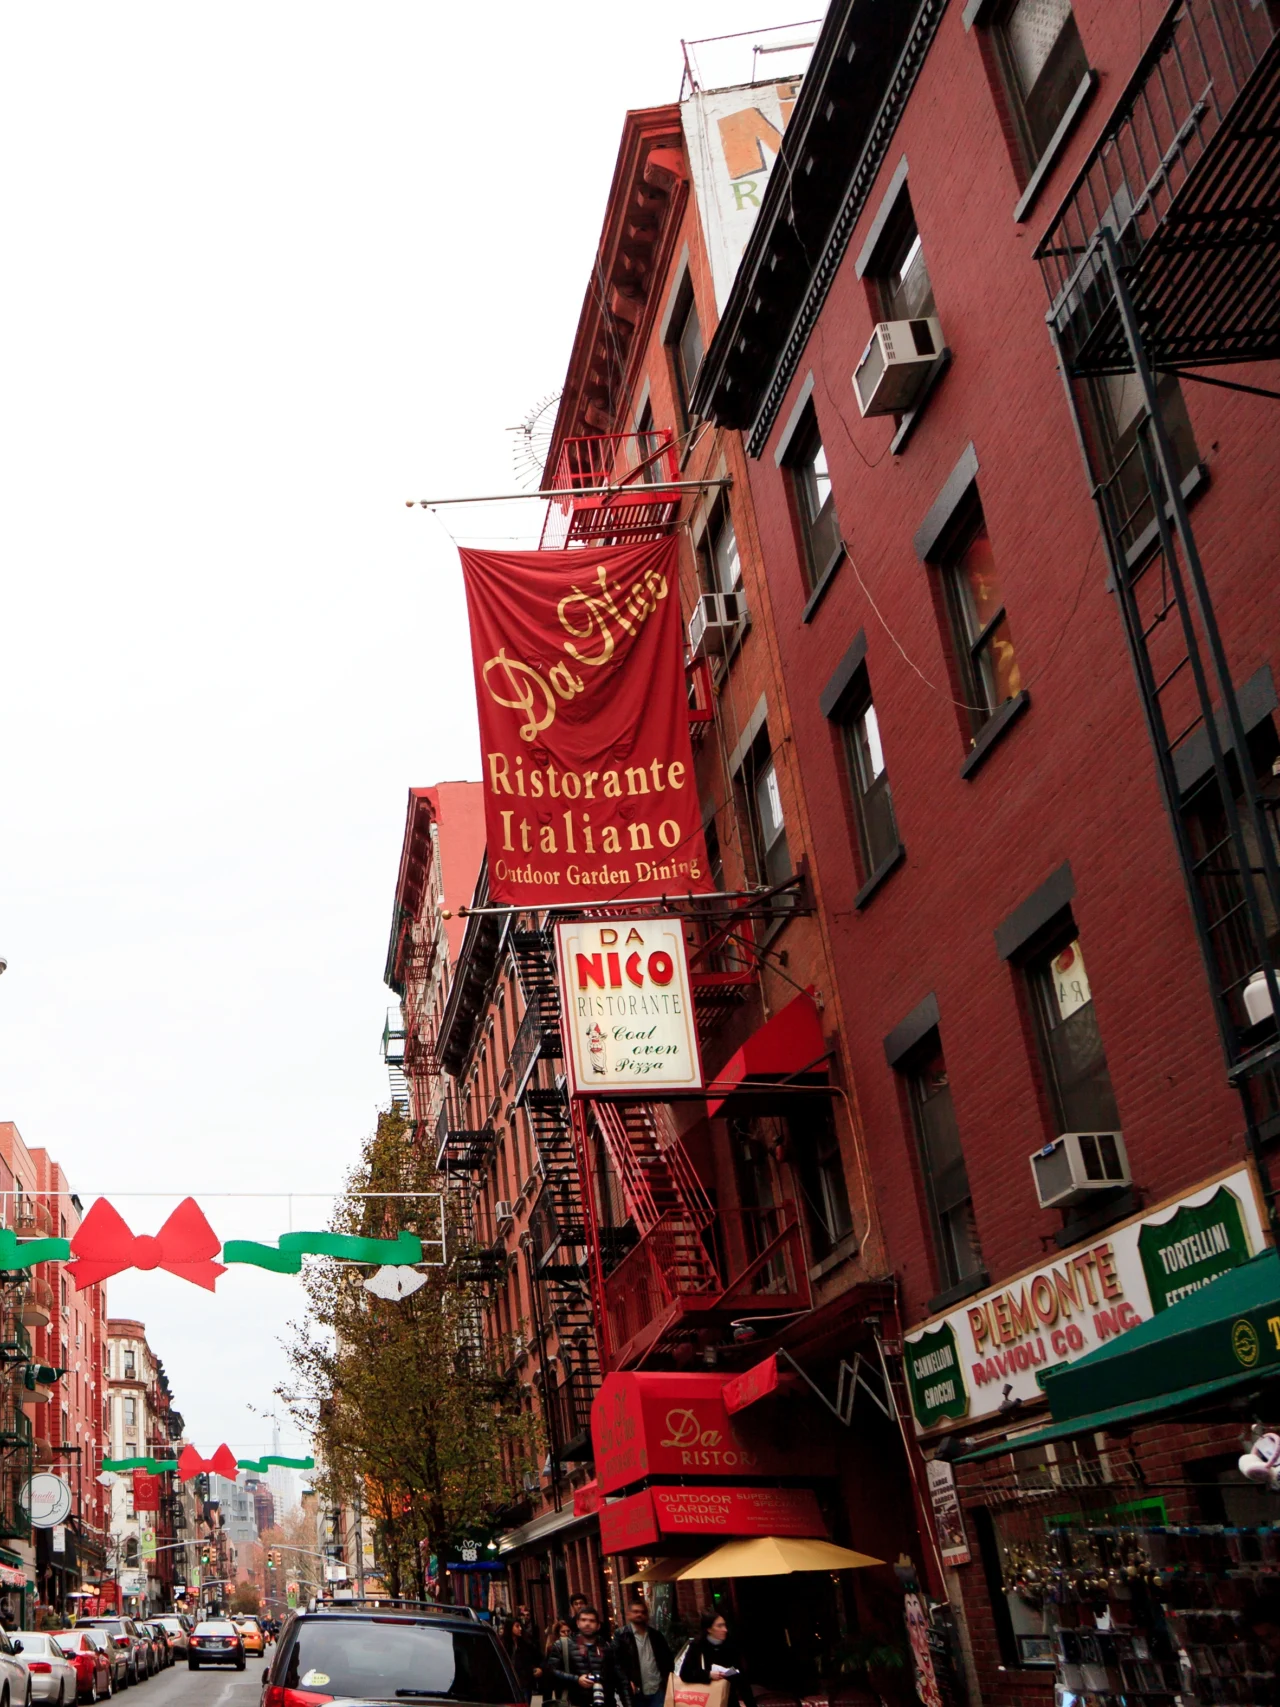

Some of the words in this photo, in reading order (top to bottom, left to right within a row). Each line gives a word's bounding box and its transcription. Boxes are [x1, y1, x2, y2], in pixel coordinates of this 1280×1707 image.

[482, 647, 584, 742] Da
[557, 565, 669, 667] Nico
[487, 751, 686, 799] Ristorante
[501, 810, 682, 854] Italiano
[495, 859, 560, 885] Outdoor
[566, 864, 630, 886] Garden
[637, 857, 701, 880] Dining
[600, 927, 644, 946] DA
[576, 950, 674, 990] NICO
[577, 994, 682, 1017] RISTORANTE
[612, 1025, 657, 1042] Coal
[632, 1044, 679, 1055] oven
[614, 1058, 664, 1074] Pizza
[1158, 1222, 1231, 1275] TORTELLINI
[966, 1243, 1124, 1355] PIEMONTE
[913, 1345, 954, 1380] CANNELLONI
[971, 1337, 1047, 1387] RAVIOLI
[924, 1379, 956, 1410] GNOCCHI
[660, 1408, 723, 1447] Da
[658, 1494, 733, 1504] OUTDOOR
[736, 1493, 772, 1501] SUPER
[666, 1504, 730, 1514] GARDEN
[673, 1514, 727, 1525] DINING
